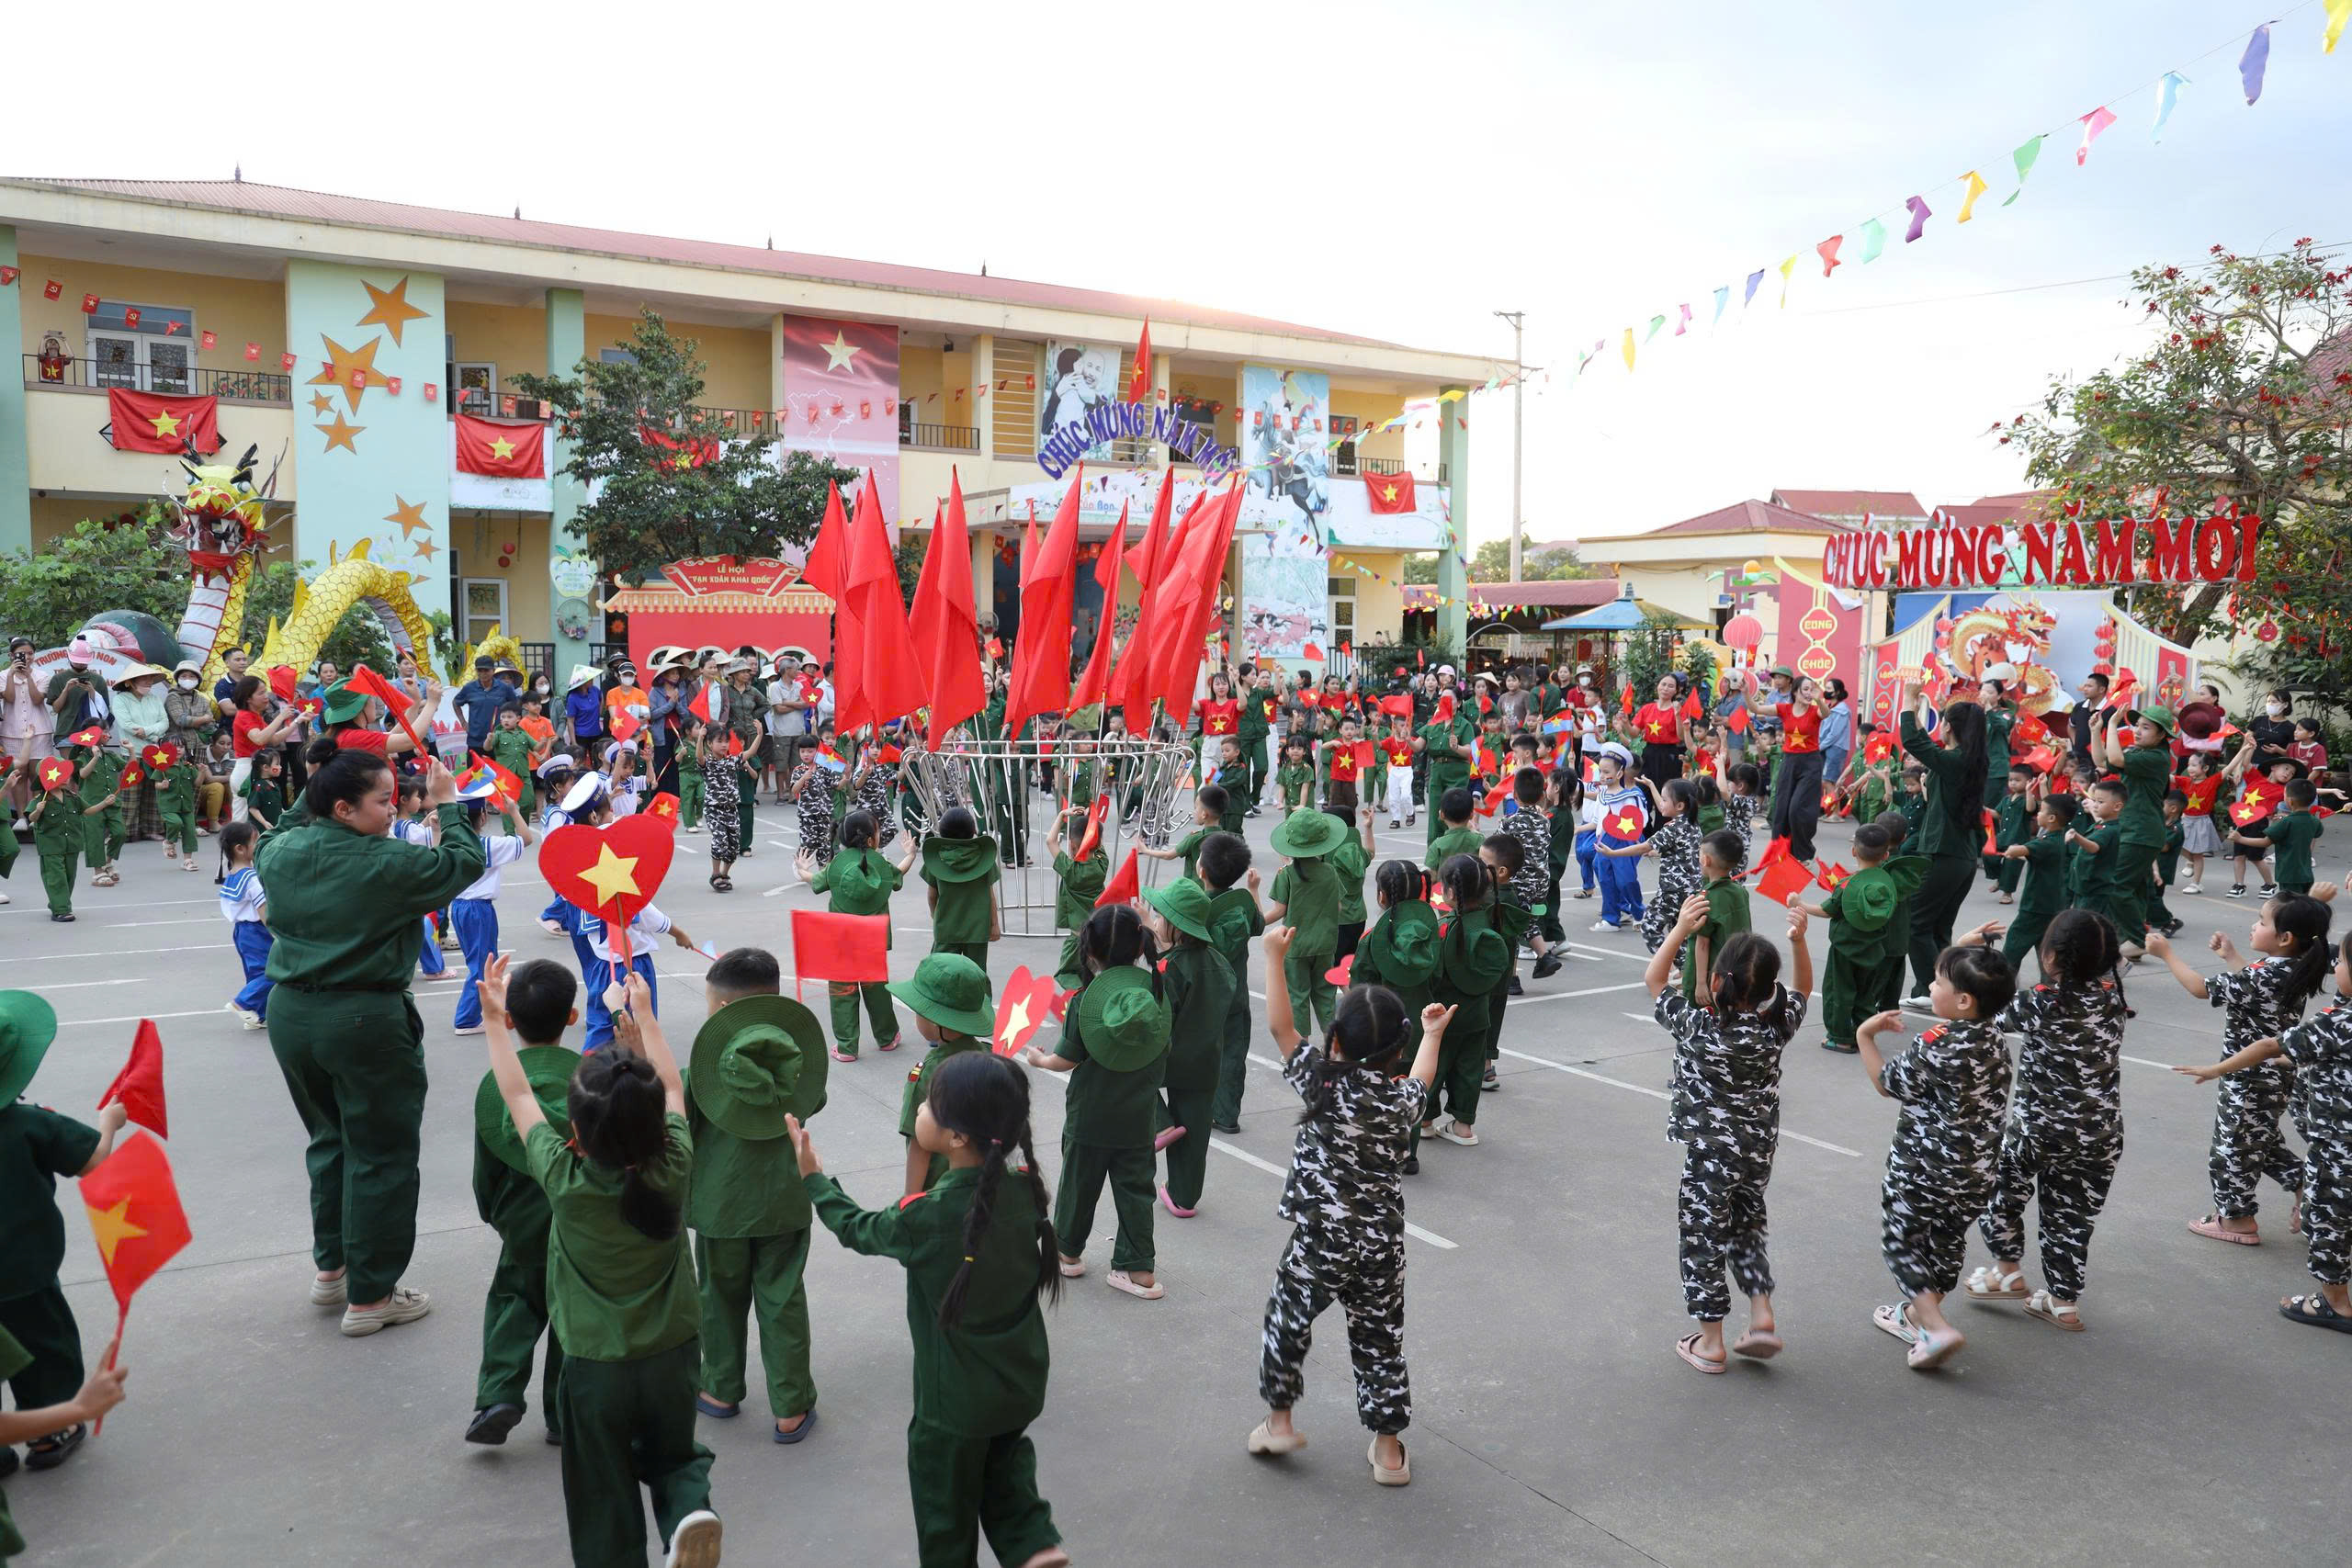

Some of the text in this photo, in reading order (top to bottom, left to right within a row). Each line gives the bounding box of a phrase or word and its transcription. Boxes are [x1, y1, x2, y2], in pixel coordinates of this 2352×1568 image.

[1036, 421, 1091, 481] CHÚC
[1084, 394, 1145, 446] MỪNG
[1823, 495, 2262, 588] CHÚC MỪNG NĂM MỚI
